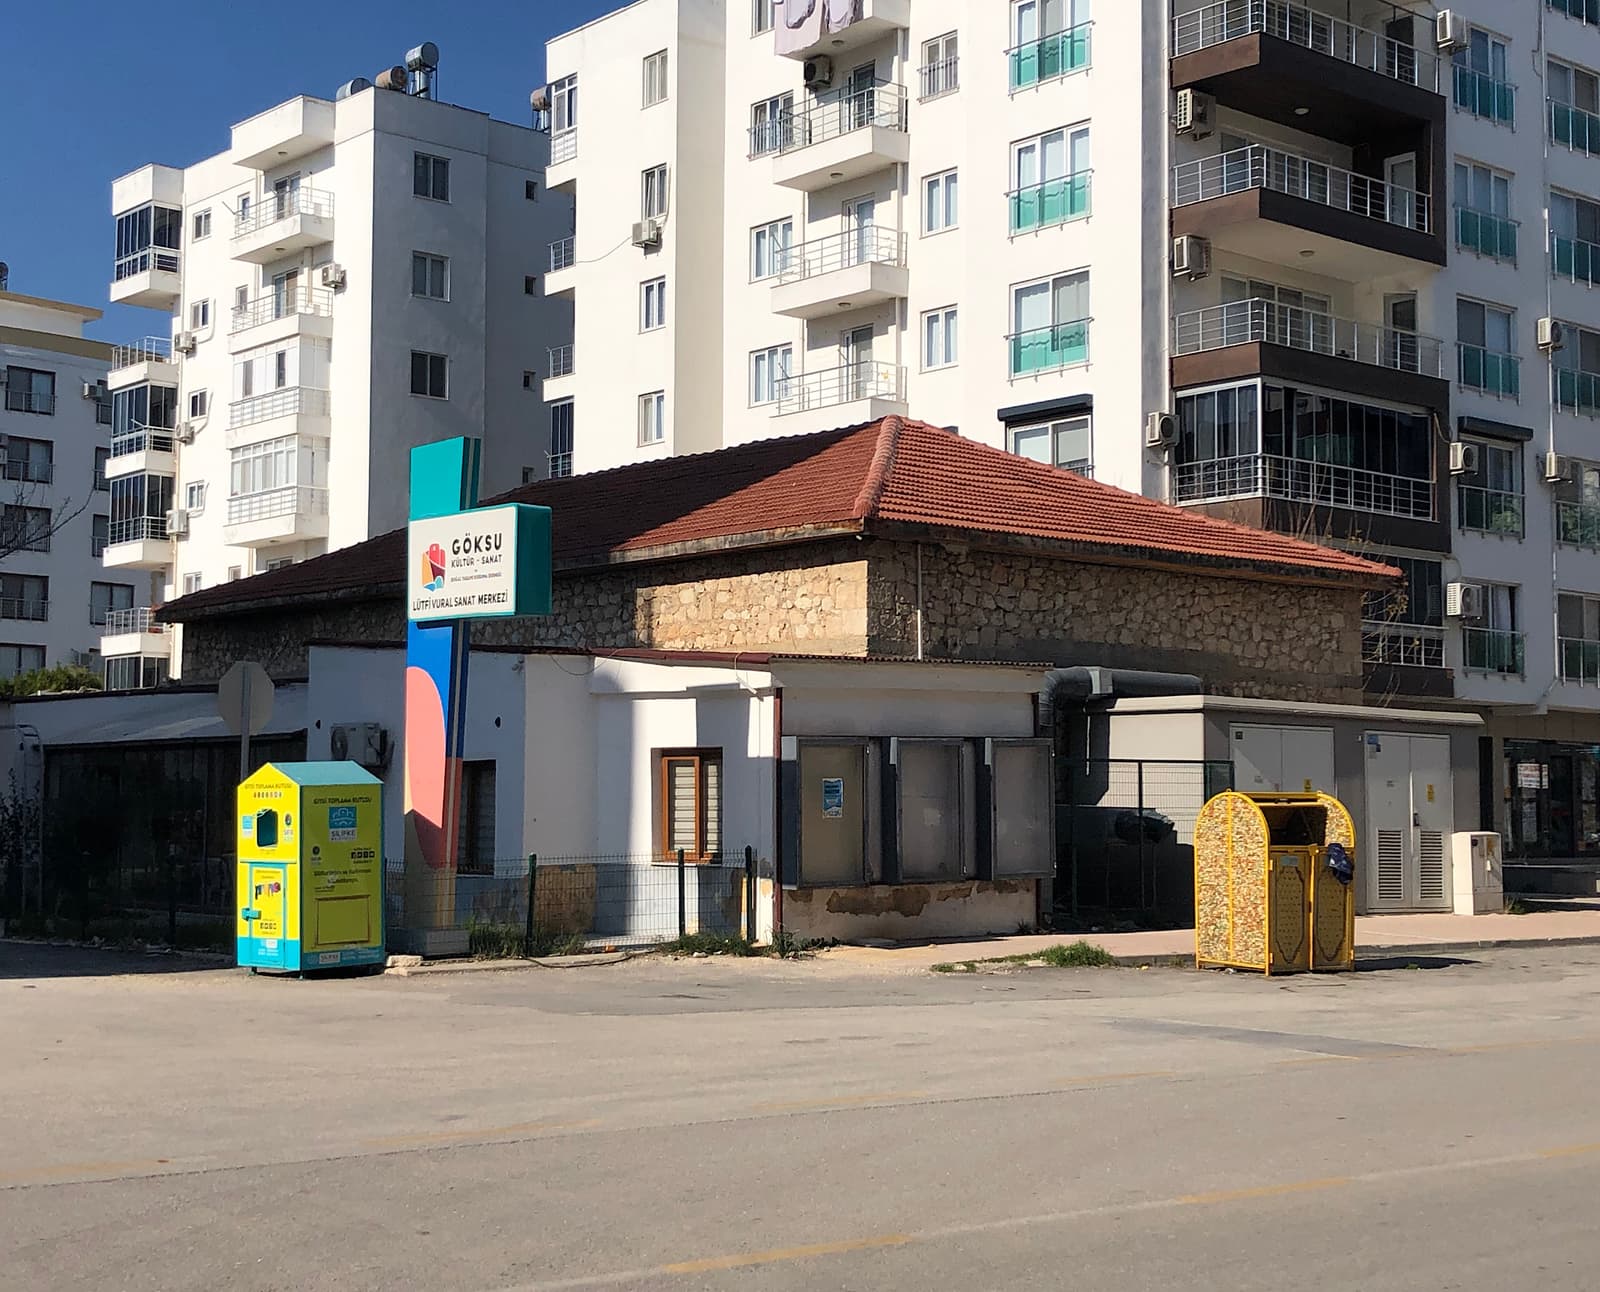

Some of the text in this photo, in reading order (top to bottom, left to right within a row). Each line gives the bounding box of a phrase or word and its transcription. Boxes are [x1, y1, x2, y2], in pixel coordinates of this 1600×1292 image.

[451, 532, 502, 555] GÖKSU
[451, 556, 475, 568] KÜLTÜR
[481, 554, 502, 565] SANAT
[413, 589, 508, 611] LÜTFİ VURAL SANAT MERKEZİ
